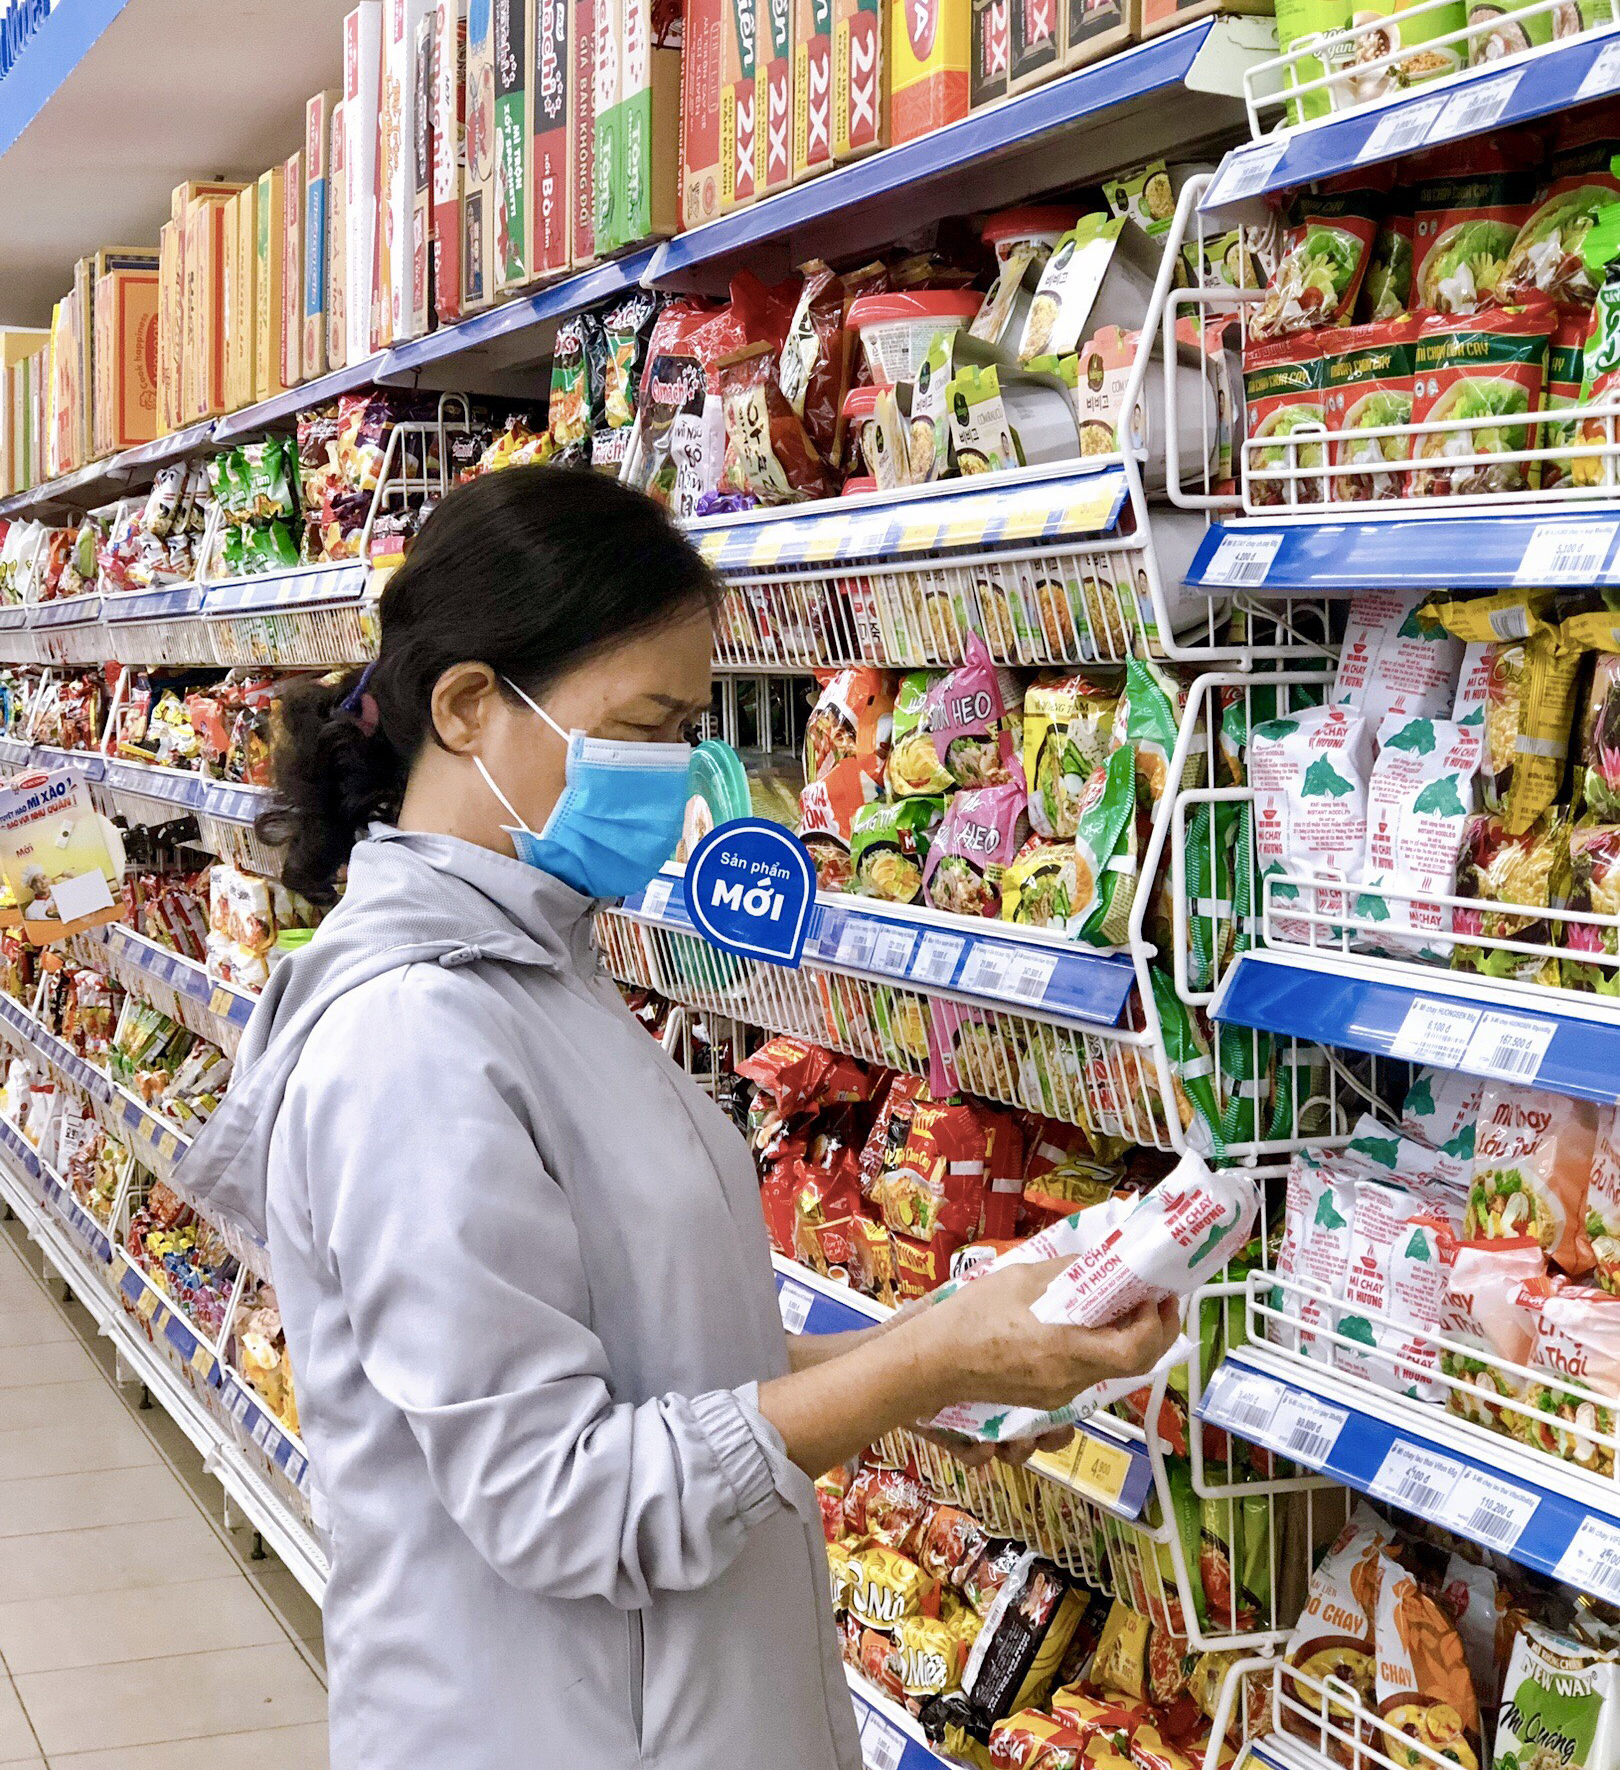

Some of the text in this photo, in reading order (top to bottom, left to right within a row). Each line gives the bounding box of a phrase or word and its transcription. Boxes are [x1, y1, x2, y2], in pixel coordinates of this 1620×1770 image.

[990, 2, 1007, 77] 2X
[1033, 0, 1049, 46] X
[579, 35, 588, 68] GIÁ
[579, 78, 588, 118] BÁN
[850, 28, 875, 135] 2X
[808, 51, 829, 154] 2X
[736, 94, 755, 190] 2X
[768, 74, 788, 175] 2X
[514, 144, 523, 191] TRỘN
[579, 121, 588, 190] KHÔNG
[540, 178, 554, 216] Bò
[1552, 357, 1566, 372] AY
[652, 375, 688, 405] Omachi
[951, 691, 992, 727] HEO
[960, 820, 1000, 855] HEO
[720, 851, 791, 881] Sản phẩm
[710, 876, 785, 922] MỚI
[1418, 912, 1443, 927] CHAY
[1526, 1039, 1534, 1050] đ
[1170, 1194, 1213, 1240] MÌ CHAY
[1190, 1203, 1226, 1236] HƯƠNG
[1067, 1243, 1111, 1283] MÌ CHA
[1075, 1254, 1123, 1296] VỊ HƯƠN
[1348, 1275, 1385, 1294] MÌ CHAY
[1356, 1290, 1384, 1309] HƯƠNG
[1545, 1341, 1589, 1378] Thái
[1424, 1474, 1431, 1484] đ
[1480, 1496, 1514, 1518] 110.200 đ
[1321, 1602, 1364, 1636] CHAY
[1380, 1661, 1412, 1688] CHAY
[1519, 1653, 1595, 1698] NEW WAY
[1499, 1699, 1524, 1735] Mì
